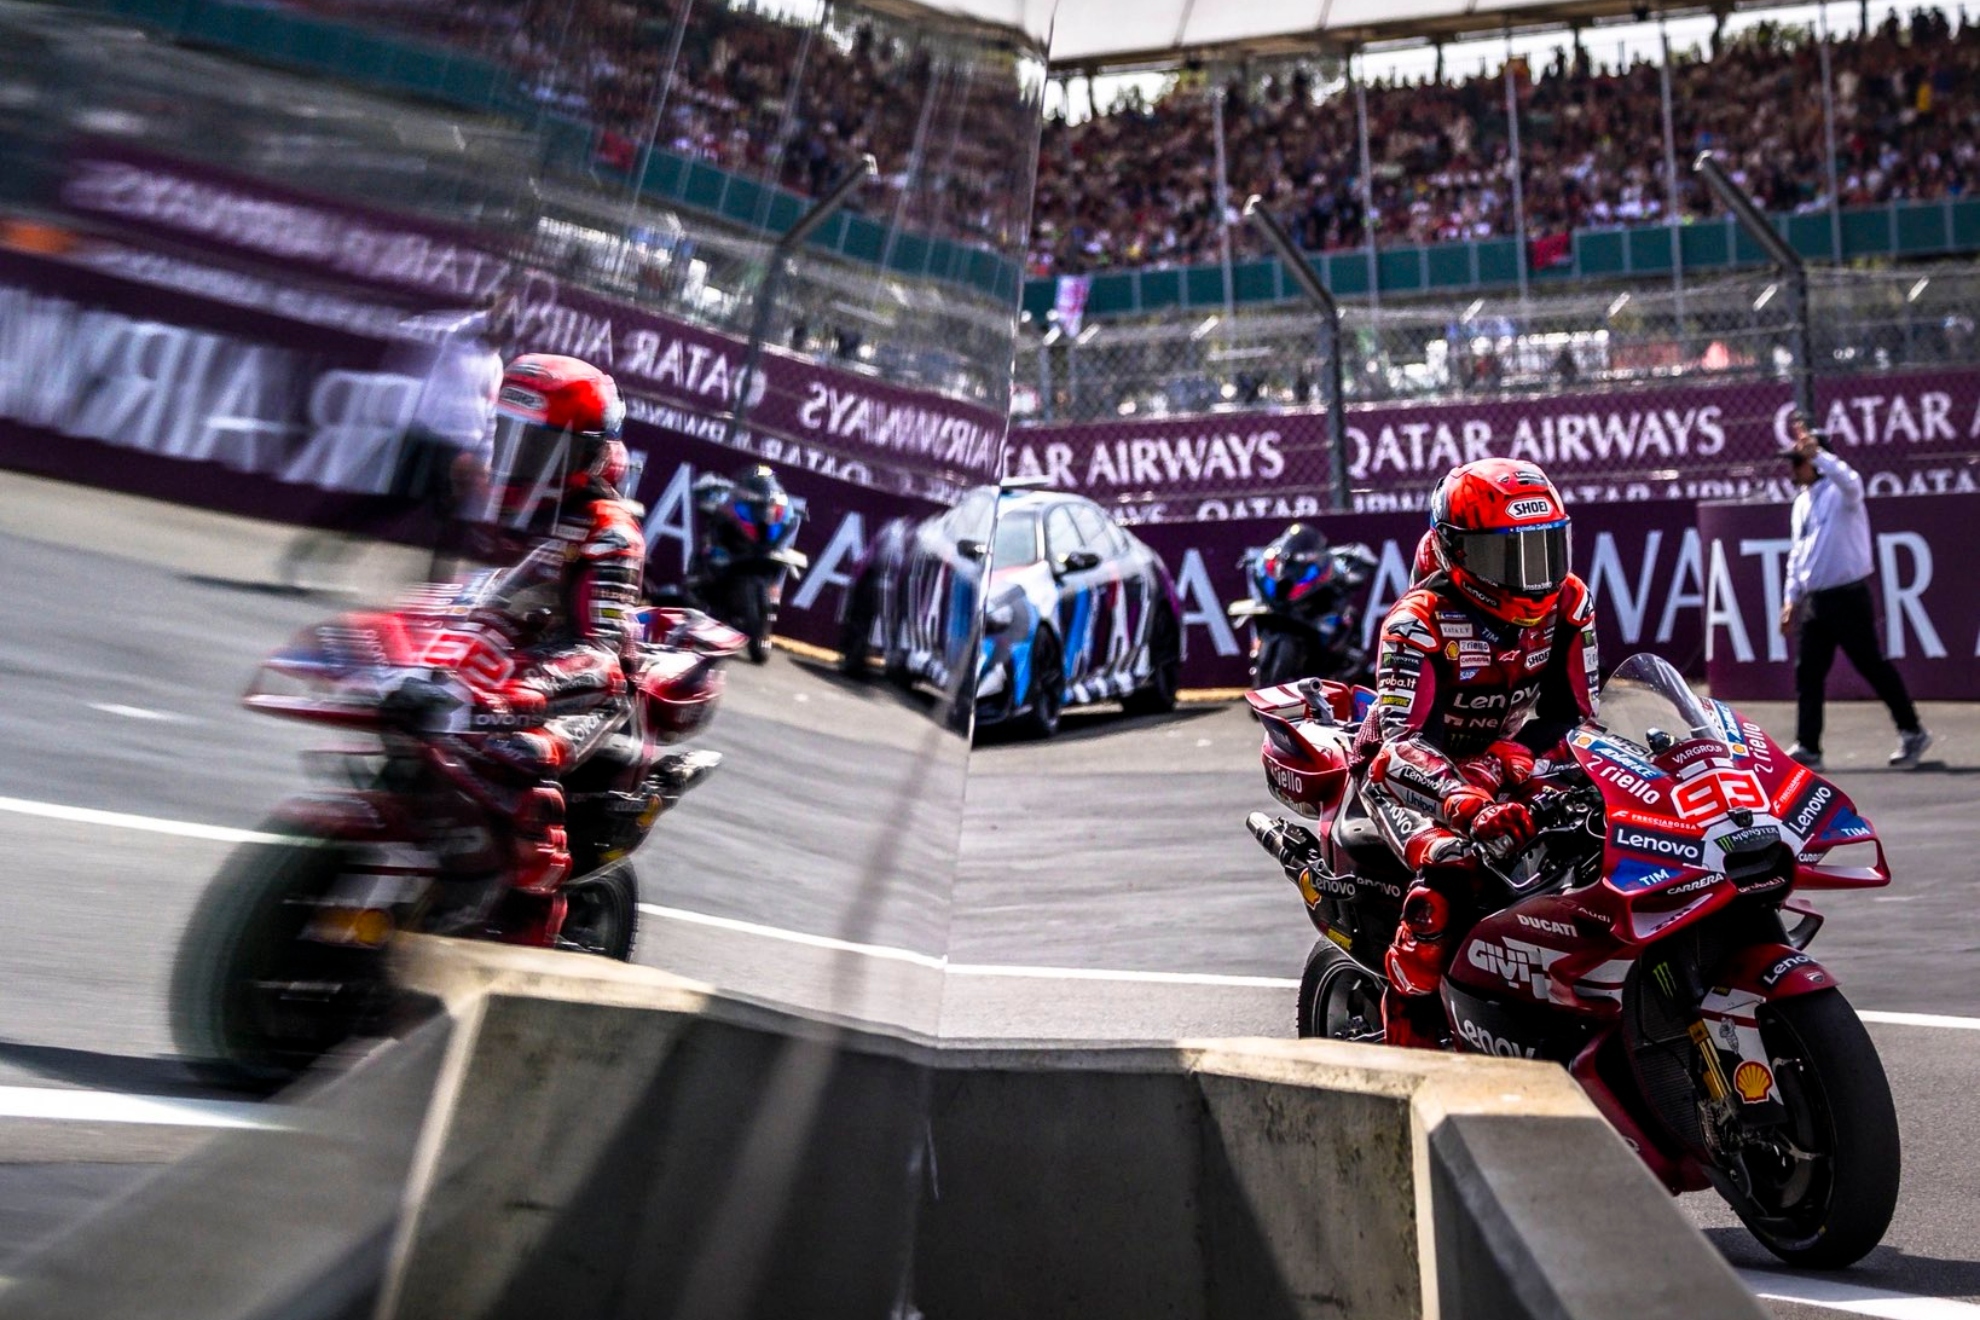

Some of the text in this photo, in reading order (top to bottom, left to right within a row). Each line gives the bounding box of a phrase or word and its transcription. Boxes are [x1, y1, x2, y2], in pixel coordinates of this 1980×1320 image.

[1510, 405, 1725, 464] AIRWAYS
[1003, 430, 1285, 487] TAR AIRWAYS
[1868, 468, 1979, 498] QATA
[1513, 501, 1548, 516] SHOEI
[1462, 580, 1498, 607] Lenovo
[1481, 627, 1499, 642] TIM
[1453, 681, 1540, 709] Lenov
[1742, 722, 1772, 762] riello
[1599, 765, 1661, 805] riello
[1406, 789, 1437, 815] Unipol
[1788, 786, 1832, 834] Lenovo
[1616, 828, 1699, 859] Lenovo
[1841, 826, 1871, 837] TIM
[1639, 868, 1670, 886] TIM
[1666, 873, 1724, 895] CARRERA
[1516, 913, 1578, 938] DUCATI
[1578, 906, 1611, 923] Audi
[1450, 1000, 1536, 1059] Lenov
